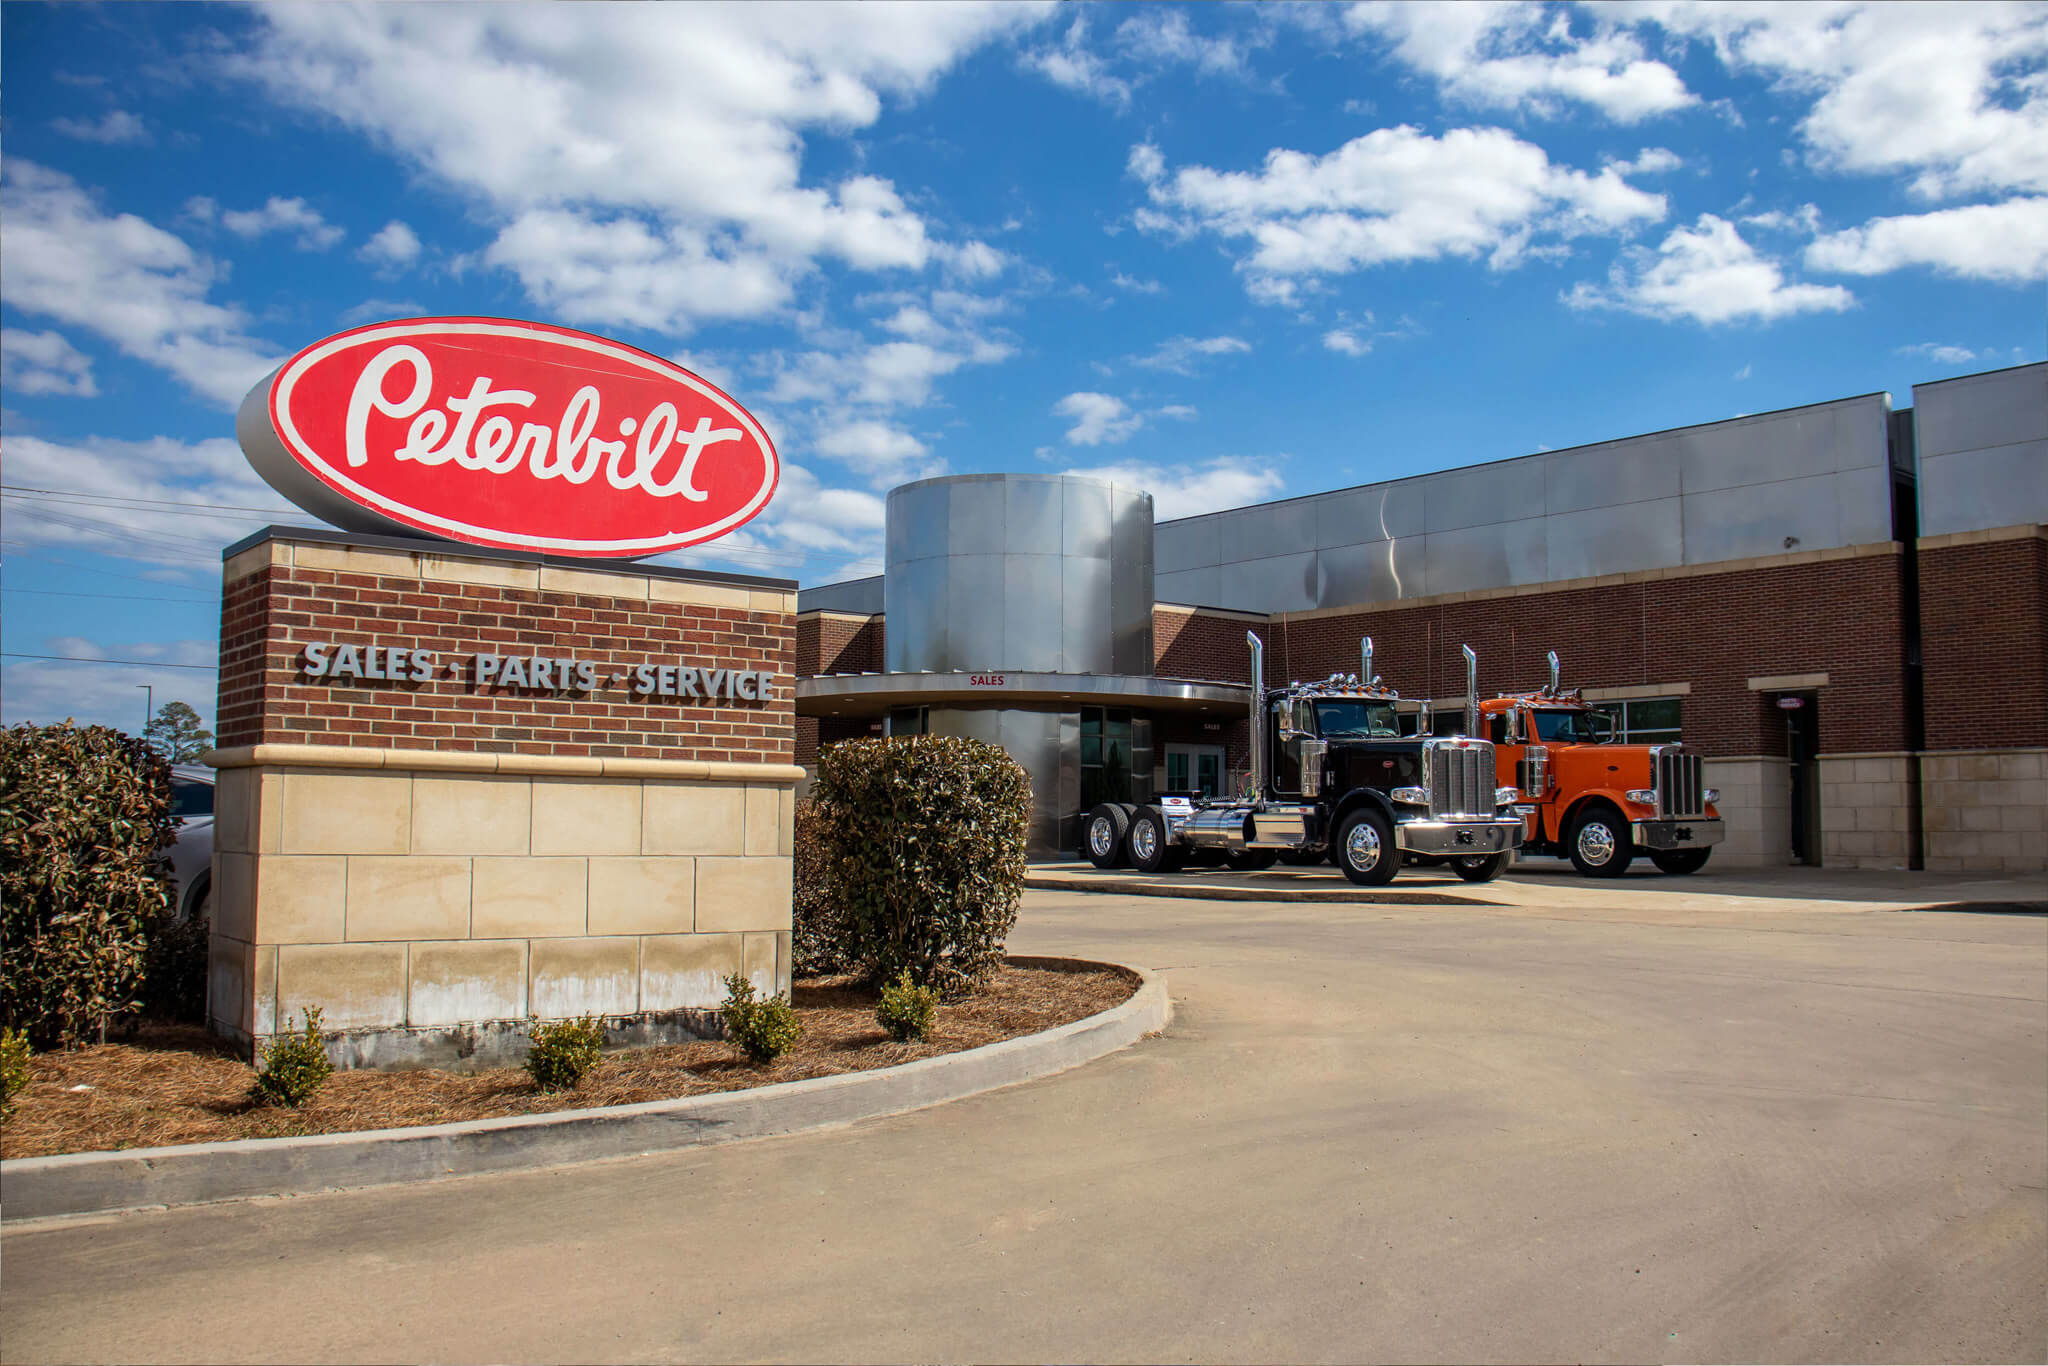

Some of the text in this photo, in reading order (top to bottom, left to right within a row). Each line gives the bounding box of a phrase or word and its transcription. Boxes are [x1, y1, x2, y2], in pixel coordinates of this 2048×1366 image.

[345, 344, 743, 502] Peterbilt
[303, 641, 774, 700] SALES PARTS SERVICE
[970, 675, 1005, 686] SALES
